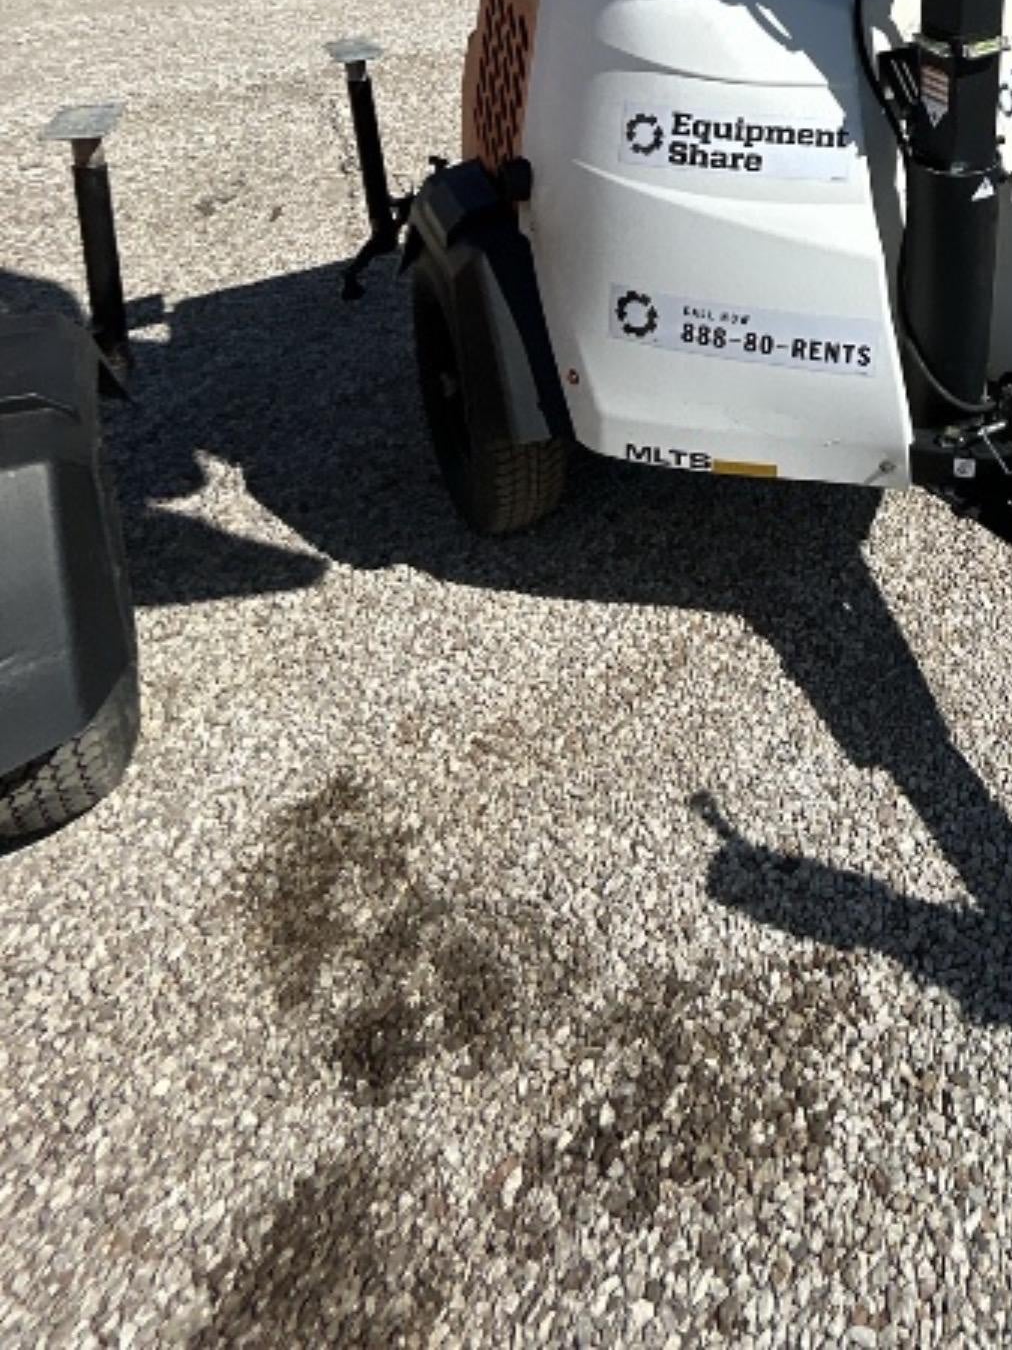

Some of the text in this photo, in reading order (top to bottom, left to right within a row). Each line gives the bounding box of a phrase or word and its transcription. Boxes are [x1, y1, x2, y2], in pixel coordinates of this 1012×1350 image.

[671, 111, 849, 148] Equipment
[668, 141, 762, 171] Share
[681, 323, 871, 367] 888-80-RENTS
